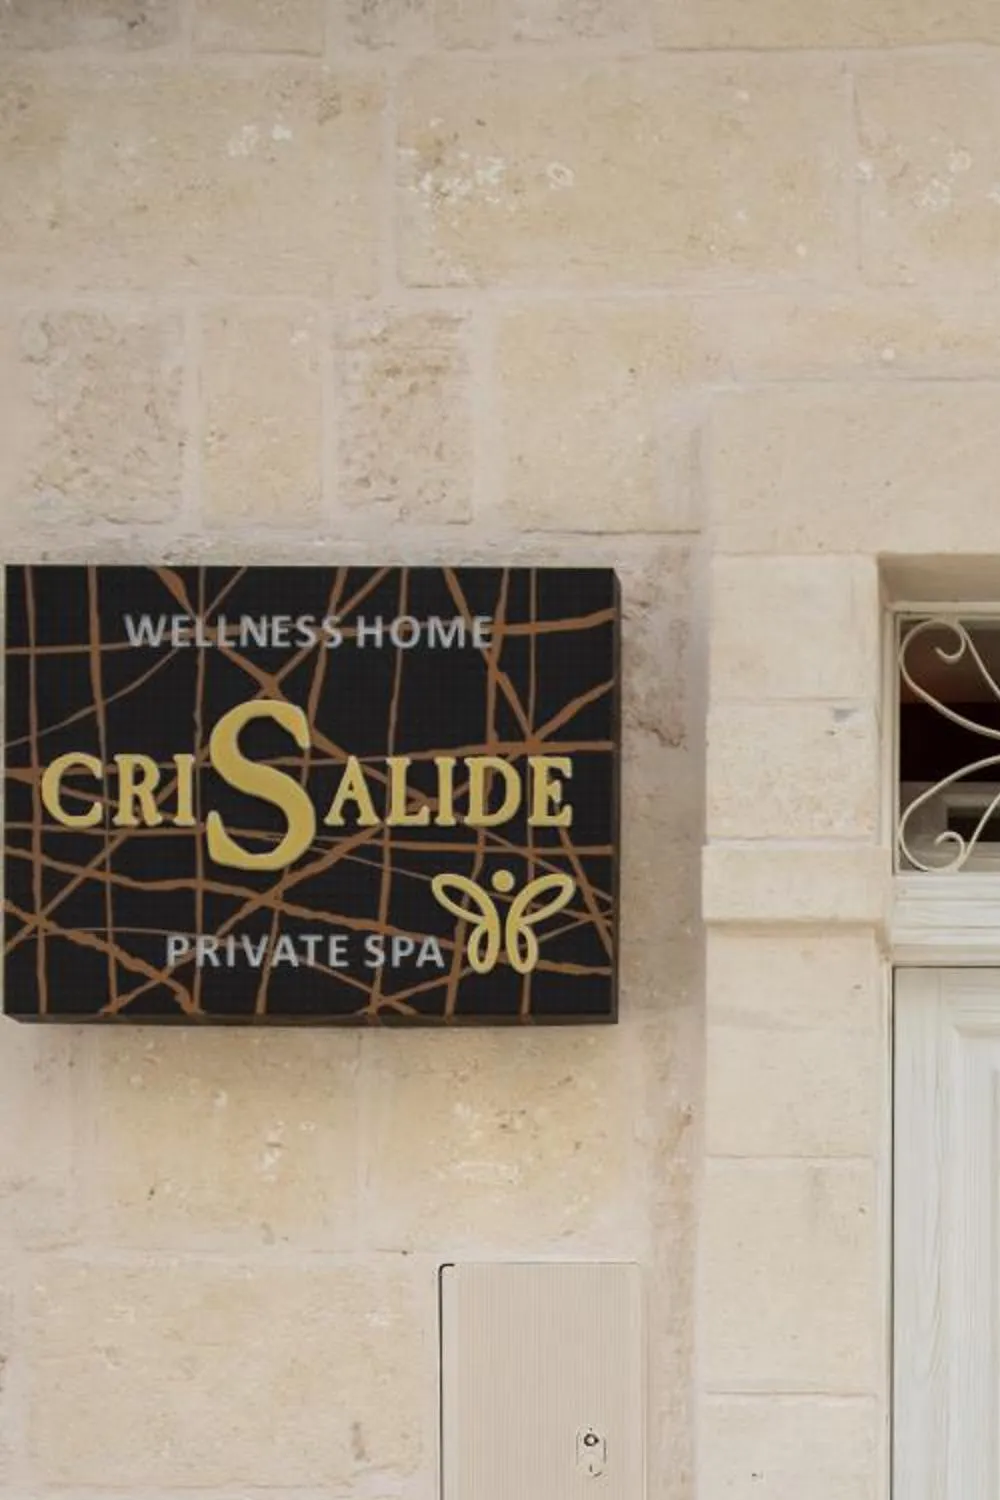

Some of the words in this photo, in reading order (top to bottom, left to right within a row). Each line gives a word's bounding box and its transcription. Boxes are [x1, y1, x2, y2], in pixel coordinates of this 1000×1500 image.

[123, 613, 344, 649] WELLNESS
[355, 614, 495, 650] HOME
[40, 698, 574, 871] CRISALIDE
[165, 934, 350, 969] PRIVATE
[363, 934, 446, 969] SPA
